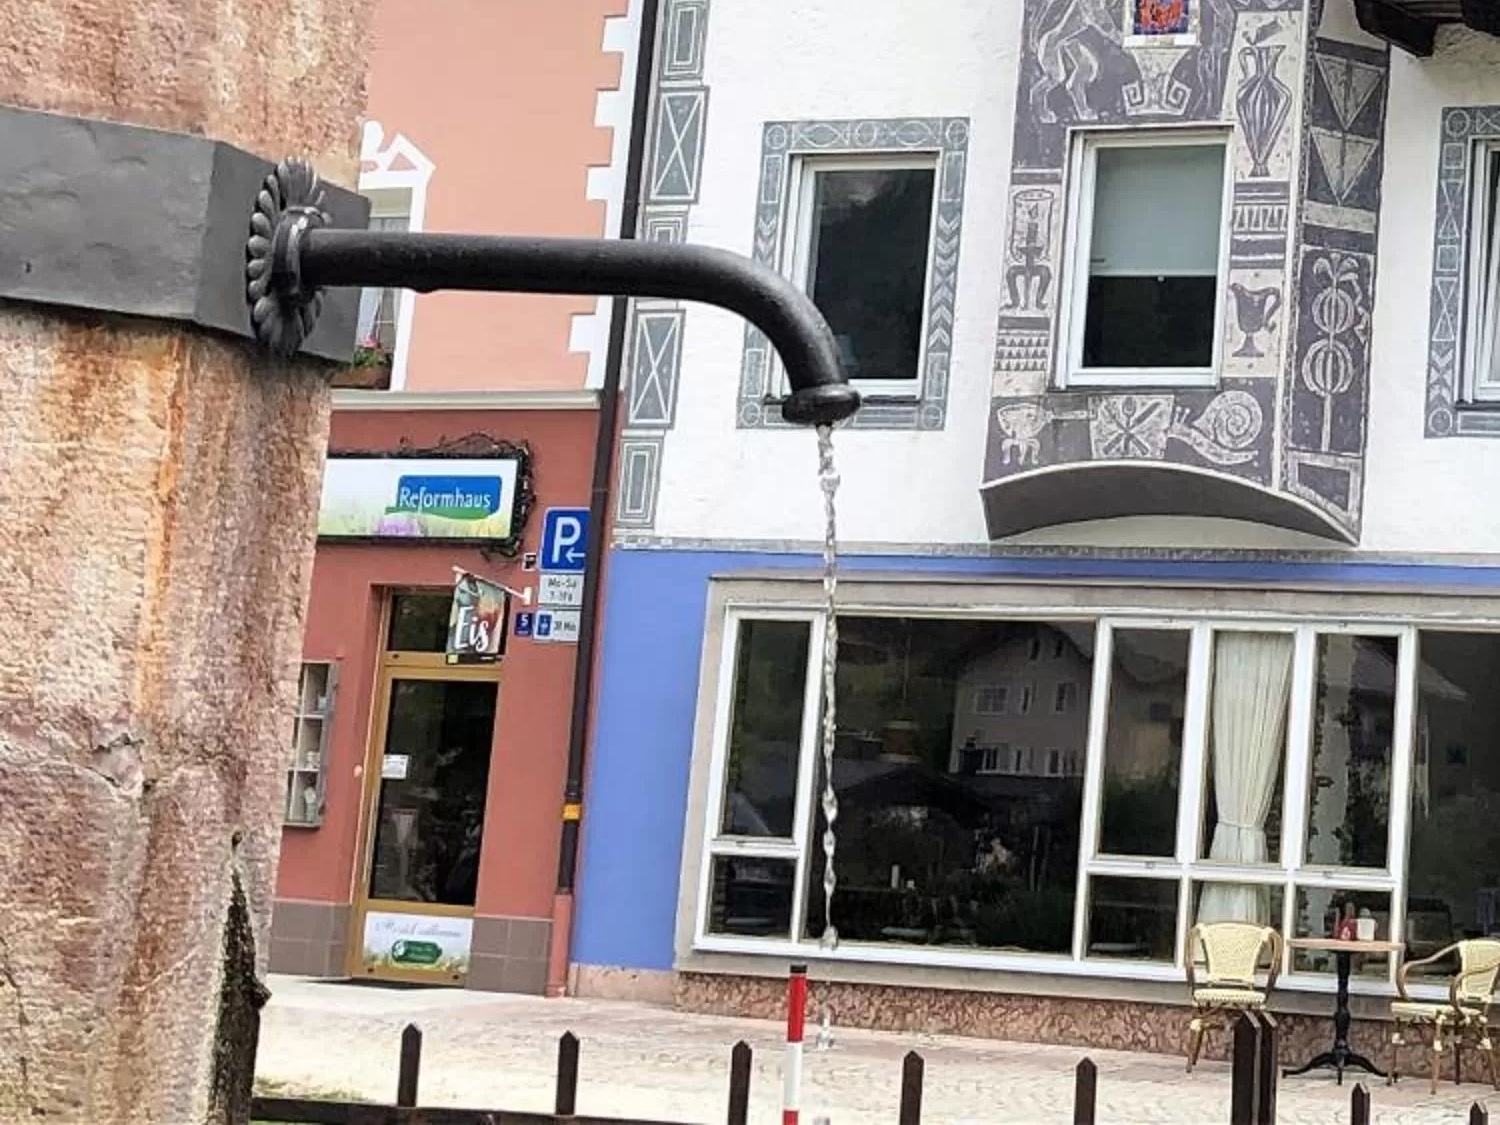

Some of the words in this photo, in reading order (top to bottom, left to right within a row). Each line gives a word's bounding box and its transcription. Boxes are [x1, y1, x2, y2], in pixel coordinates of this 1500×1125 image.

[400, 486, 491, 515] Reformhaus
[552, 516, 580, 563] P
[455, 606, 489, 652] Eis
[520, 614, 529, 627] 5
